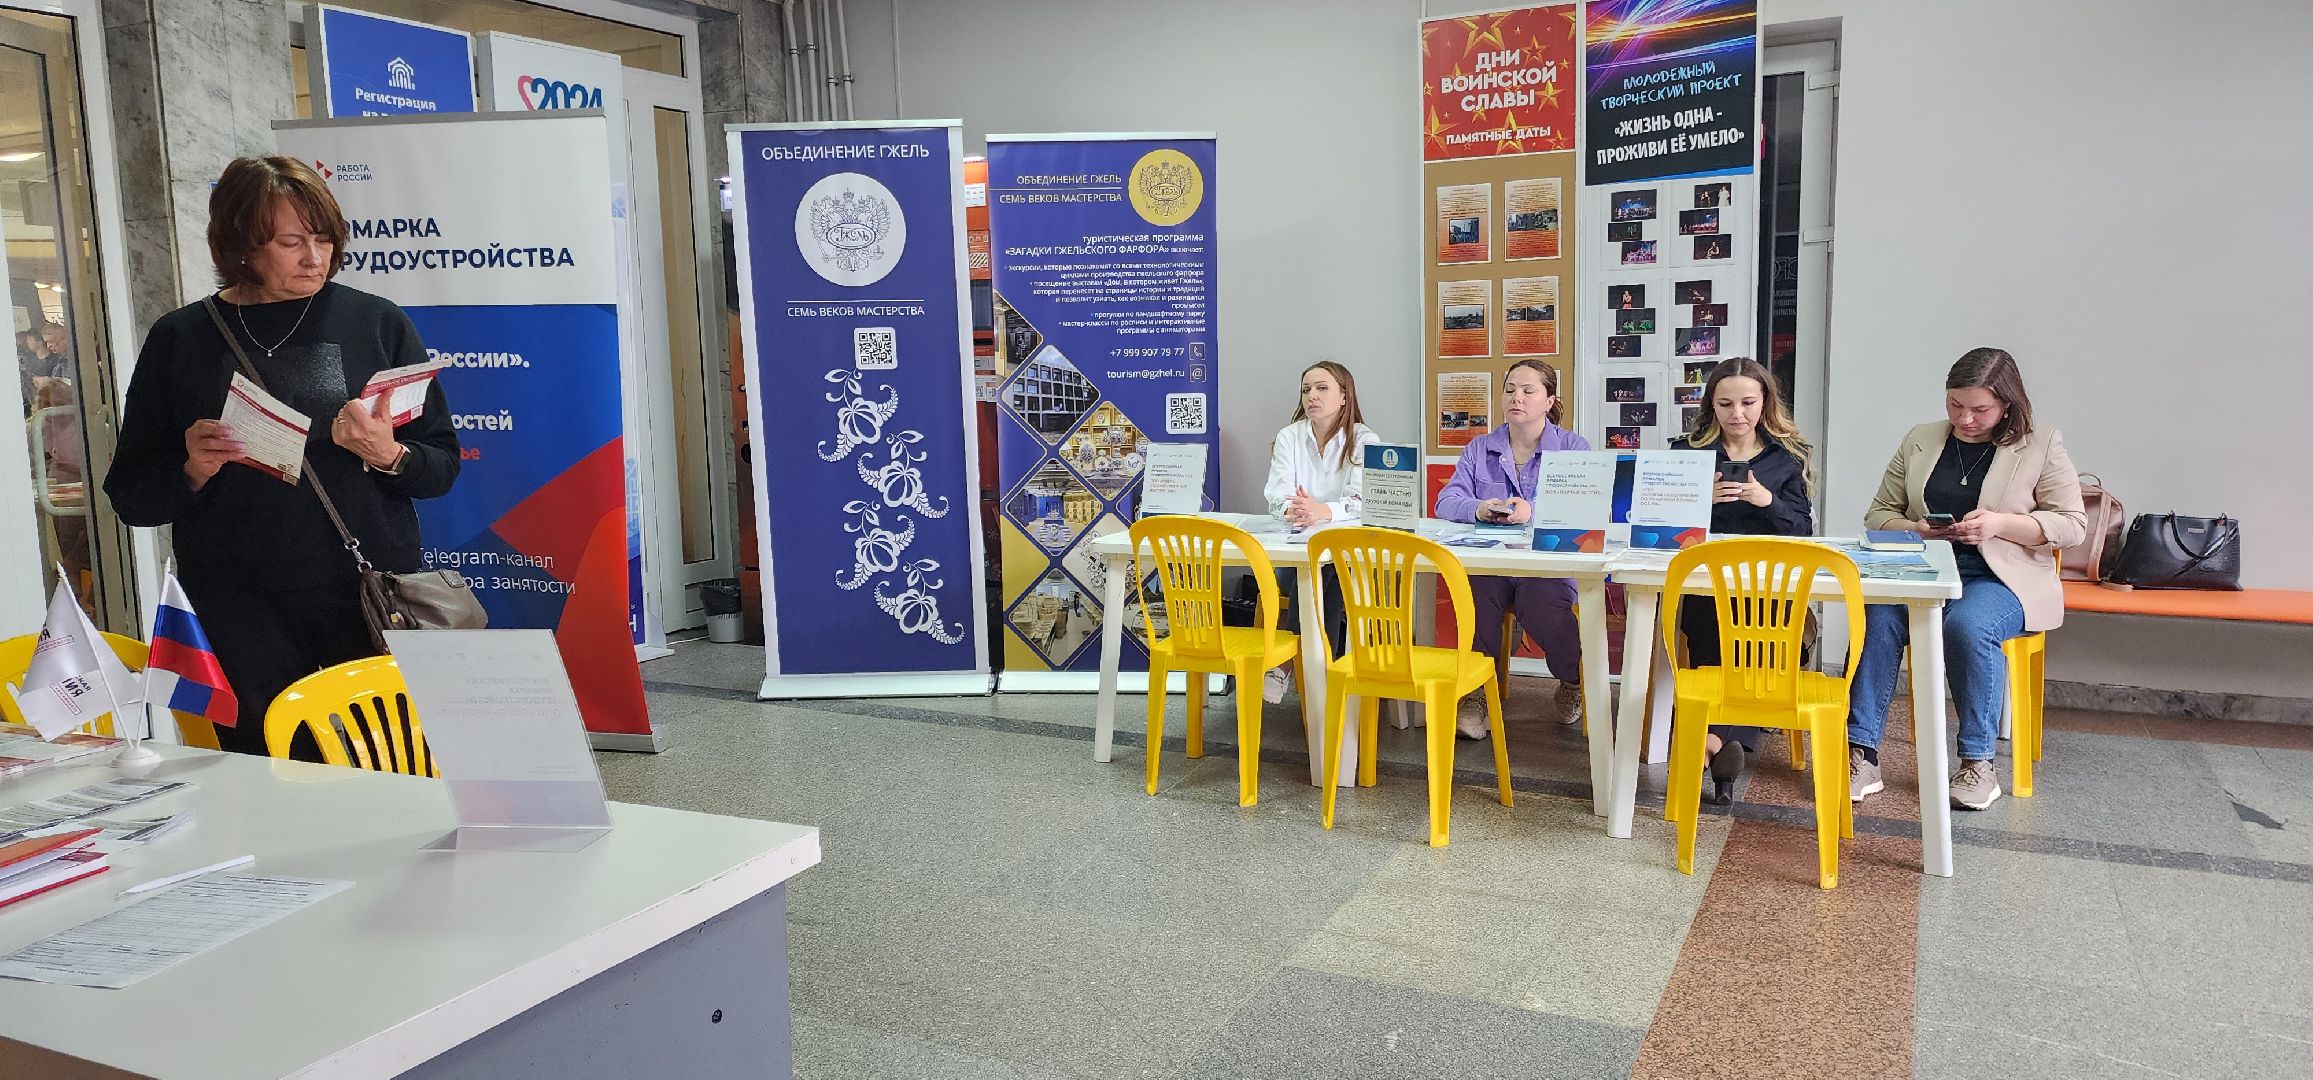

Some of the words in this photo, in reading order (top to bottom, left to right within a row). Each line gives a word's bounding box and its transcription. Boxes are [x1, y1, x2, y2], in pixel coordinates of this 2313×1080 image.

[1475, 48, 1520, 73] ДНИ
[1441, 60, 1557, 94] ВОИНСКОЙ
[355, 87, 437, 112] Регистрация
[1460, 89, 1535, 112] СЛАВЫ
[1600, 83, 1685, 110] ТВОРЧЕСКИЙ
[1689, 73, 1742, 96] ПРОЕКТ
[1614, 112, 1672, 138] «ЖИЗНЬ
[1673, 105, 1714, 129] ОДНА
[1446, 129, 1513, 145] ПАМЯТНЫЕ
[1515, 126, 1551, 140] ДАТЫ
[761, 145, 875, 163] ОБЪЕДИНЕНИЕ
[879, 144, 930, 159] ГЖЕЛЬ
[1596, 138, 1668, 166] ПРОЖИВИ
[1670, 132, 1687, 154] ЕЁ
[1688, 127, 1745, 150] УМЕЛО»
[336, 164, 370, 172] РАБОТА
[1016, 174, 1088, 187] ОБЪЕДИНЕНИЕ
[1090, 174, 1122, 184] ГЖЕЛЬ
[1000, 195, 1026, 204] СЕМЬ
[1028, 194, 1059, 204] ВЕКОВ
[1061, 193, 1122, 203] МАСТЕРСТВА
[347, 217, 442, 239] МАРКА
[1082, 234, 1149, 245] туристическая
[1152, 234, 1204, 243] программа
[340, 242, 575, 275] РУДОУСТРОЙСТВА
[1005, 246, 1052, 257] «ЗАГАДКИ
[1054, 245, 1117, 255] ГЖЕЛЬСКОГО
[1118, 244, 1170, 254] ФАРФОРА»
[1175, 270, 1204, 278] фарфора
[787, 306, 817, 318] СЕМЬ
[819, 306, 854, 317] ВЕКОВ
[856, 305, 925, 317] МАСТЕРСТВА
[1109, 348, 1121, 357] +7
[1123, 348, 1140, 357] 999
[1141, 348, 1158, 357] 907
[1160, 348, 1171, 357] 79
[1173, 347, 1184, 356] 77
[1107, 368, 1185, 380] tourism@gzhel.ru
[450, 409, 513, 431] остей
[490, 575, 577, 595] занятости
